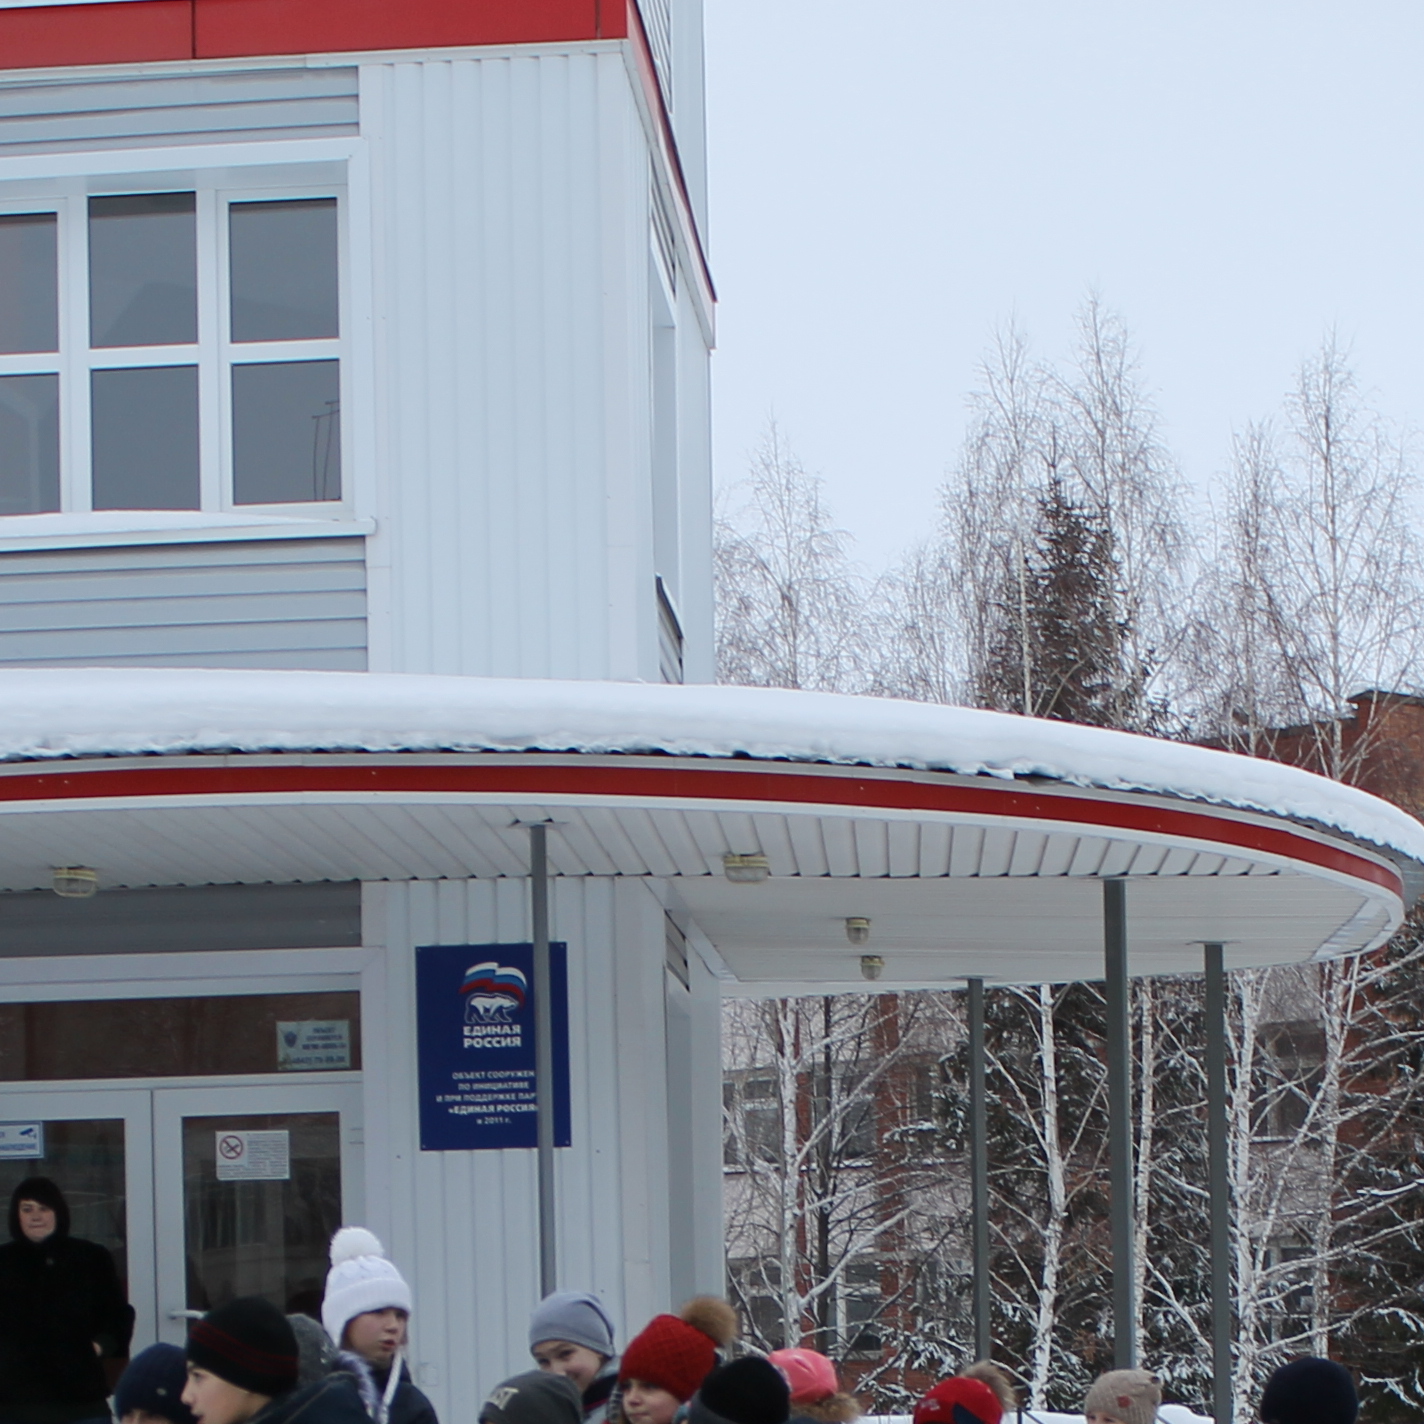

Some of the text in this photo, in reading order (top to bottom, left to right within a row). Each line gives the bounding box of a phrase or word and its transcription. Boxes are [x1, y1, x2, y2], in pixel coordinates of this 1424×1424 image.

[463, 1025, 521, 1036] ЕДИНАЯ
[463, 1037, 521, 1048] РОССИЯ
[452, 1070, 535, 1080] ОБЪЕКТ СООРУЖЕН
